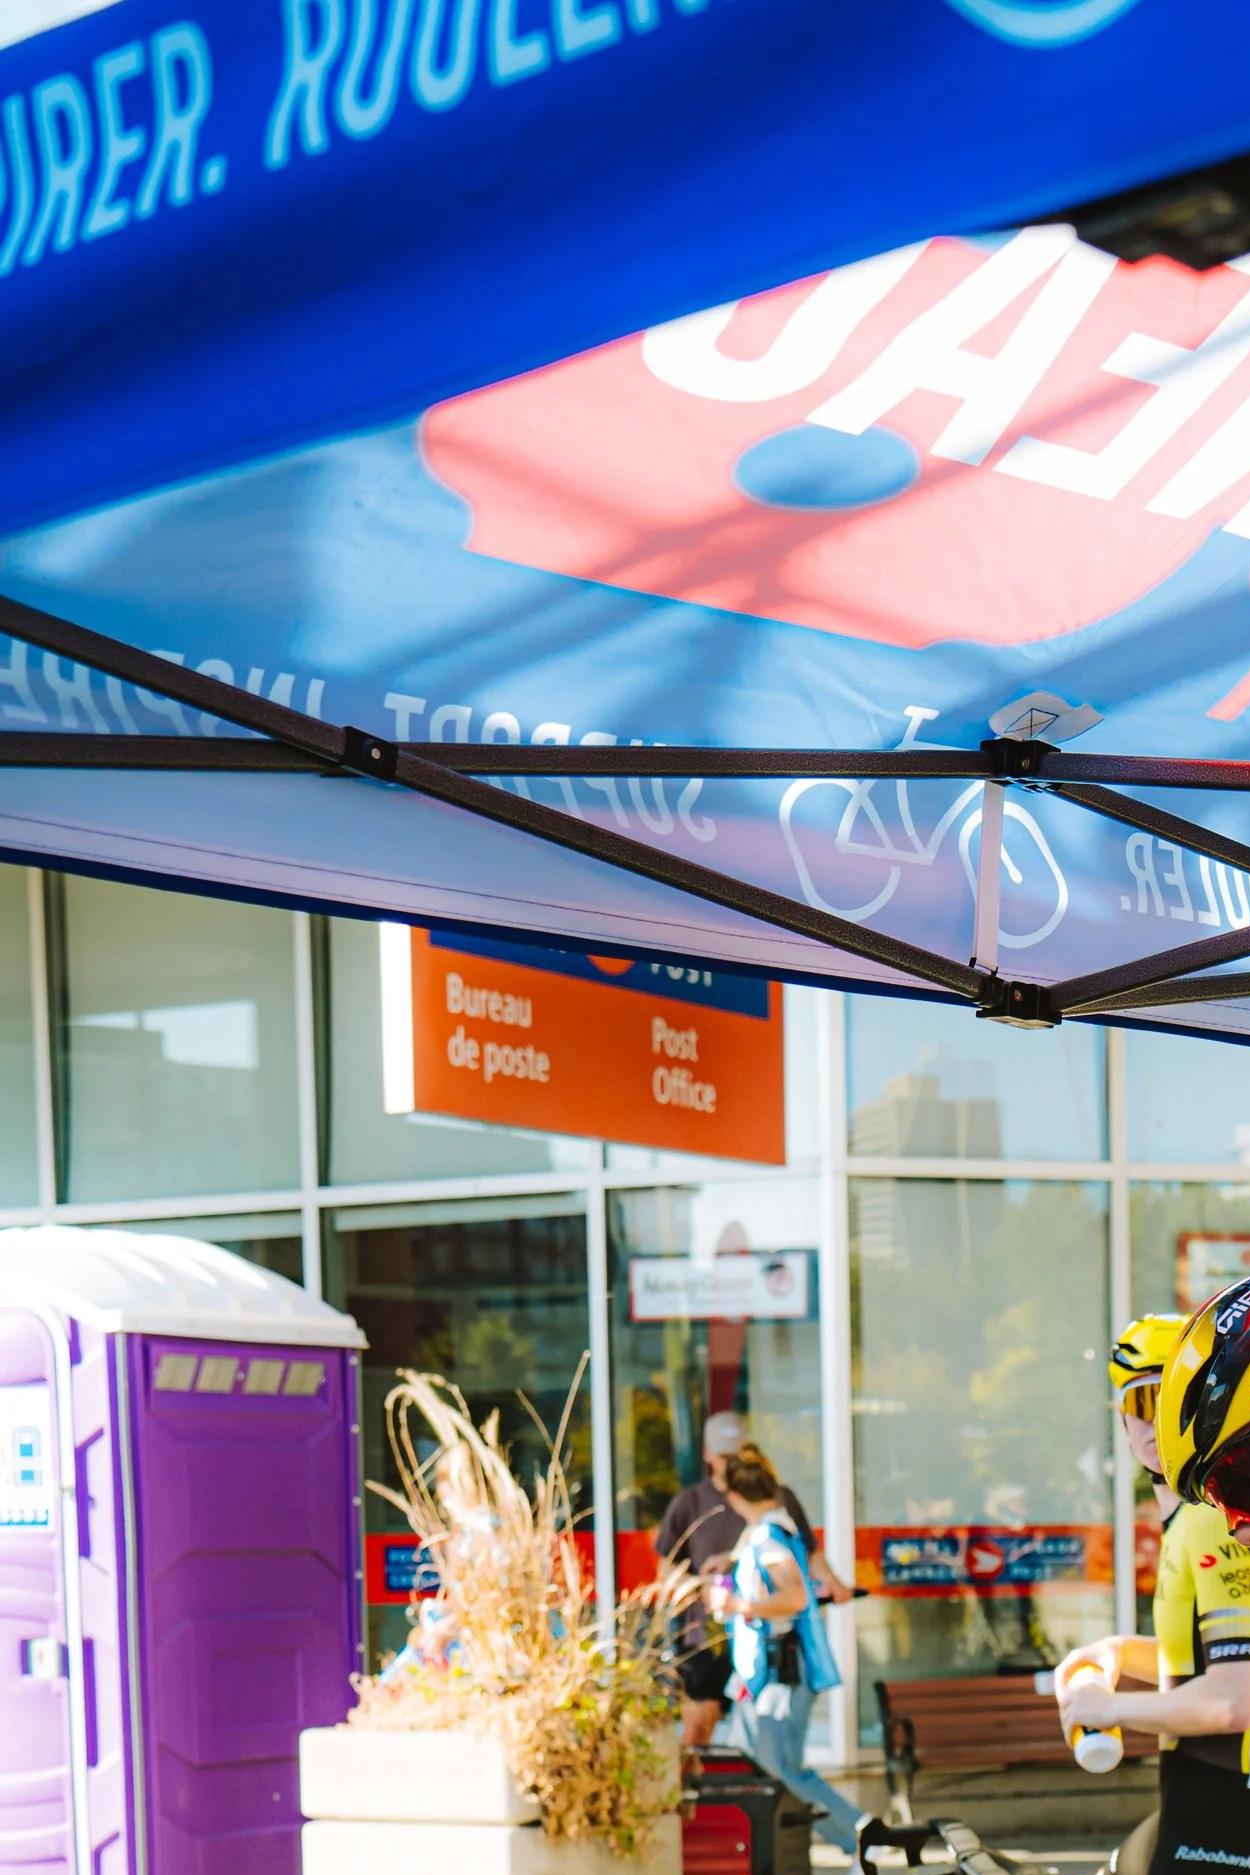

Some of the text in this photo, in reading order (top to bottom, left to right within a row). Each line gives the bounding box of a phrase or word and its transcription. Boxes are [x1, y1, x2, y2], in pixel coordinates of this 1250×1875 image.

[445, 972, 533, 1029] Bureau
[447, 1025, 551, 1083] de poste
[651, 1016, 699, 1063] Post
[652, 1066, 717, 1113] Office
